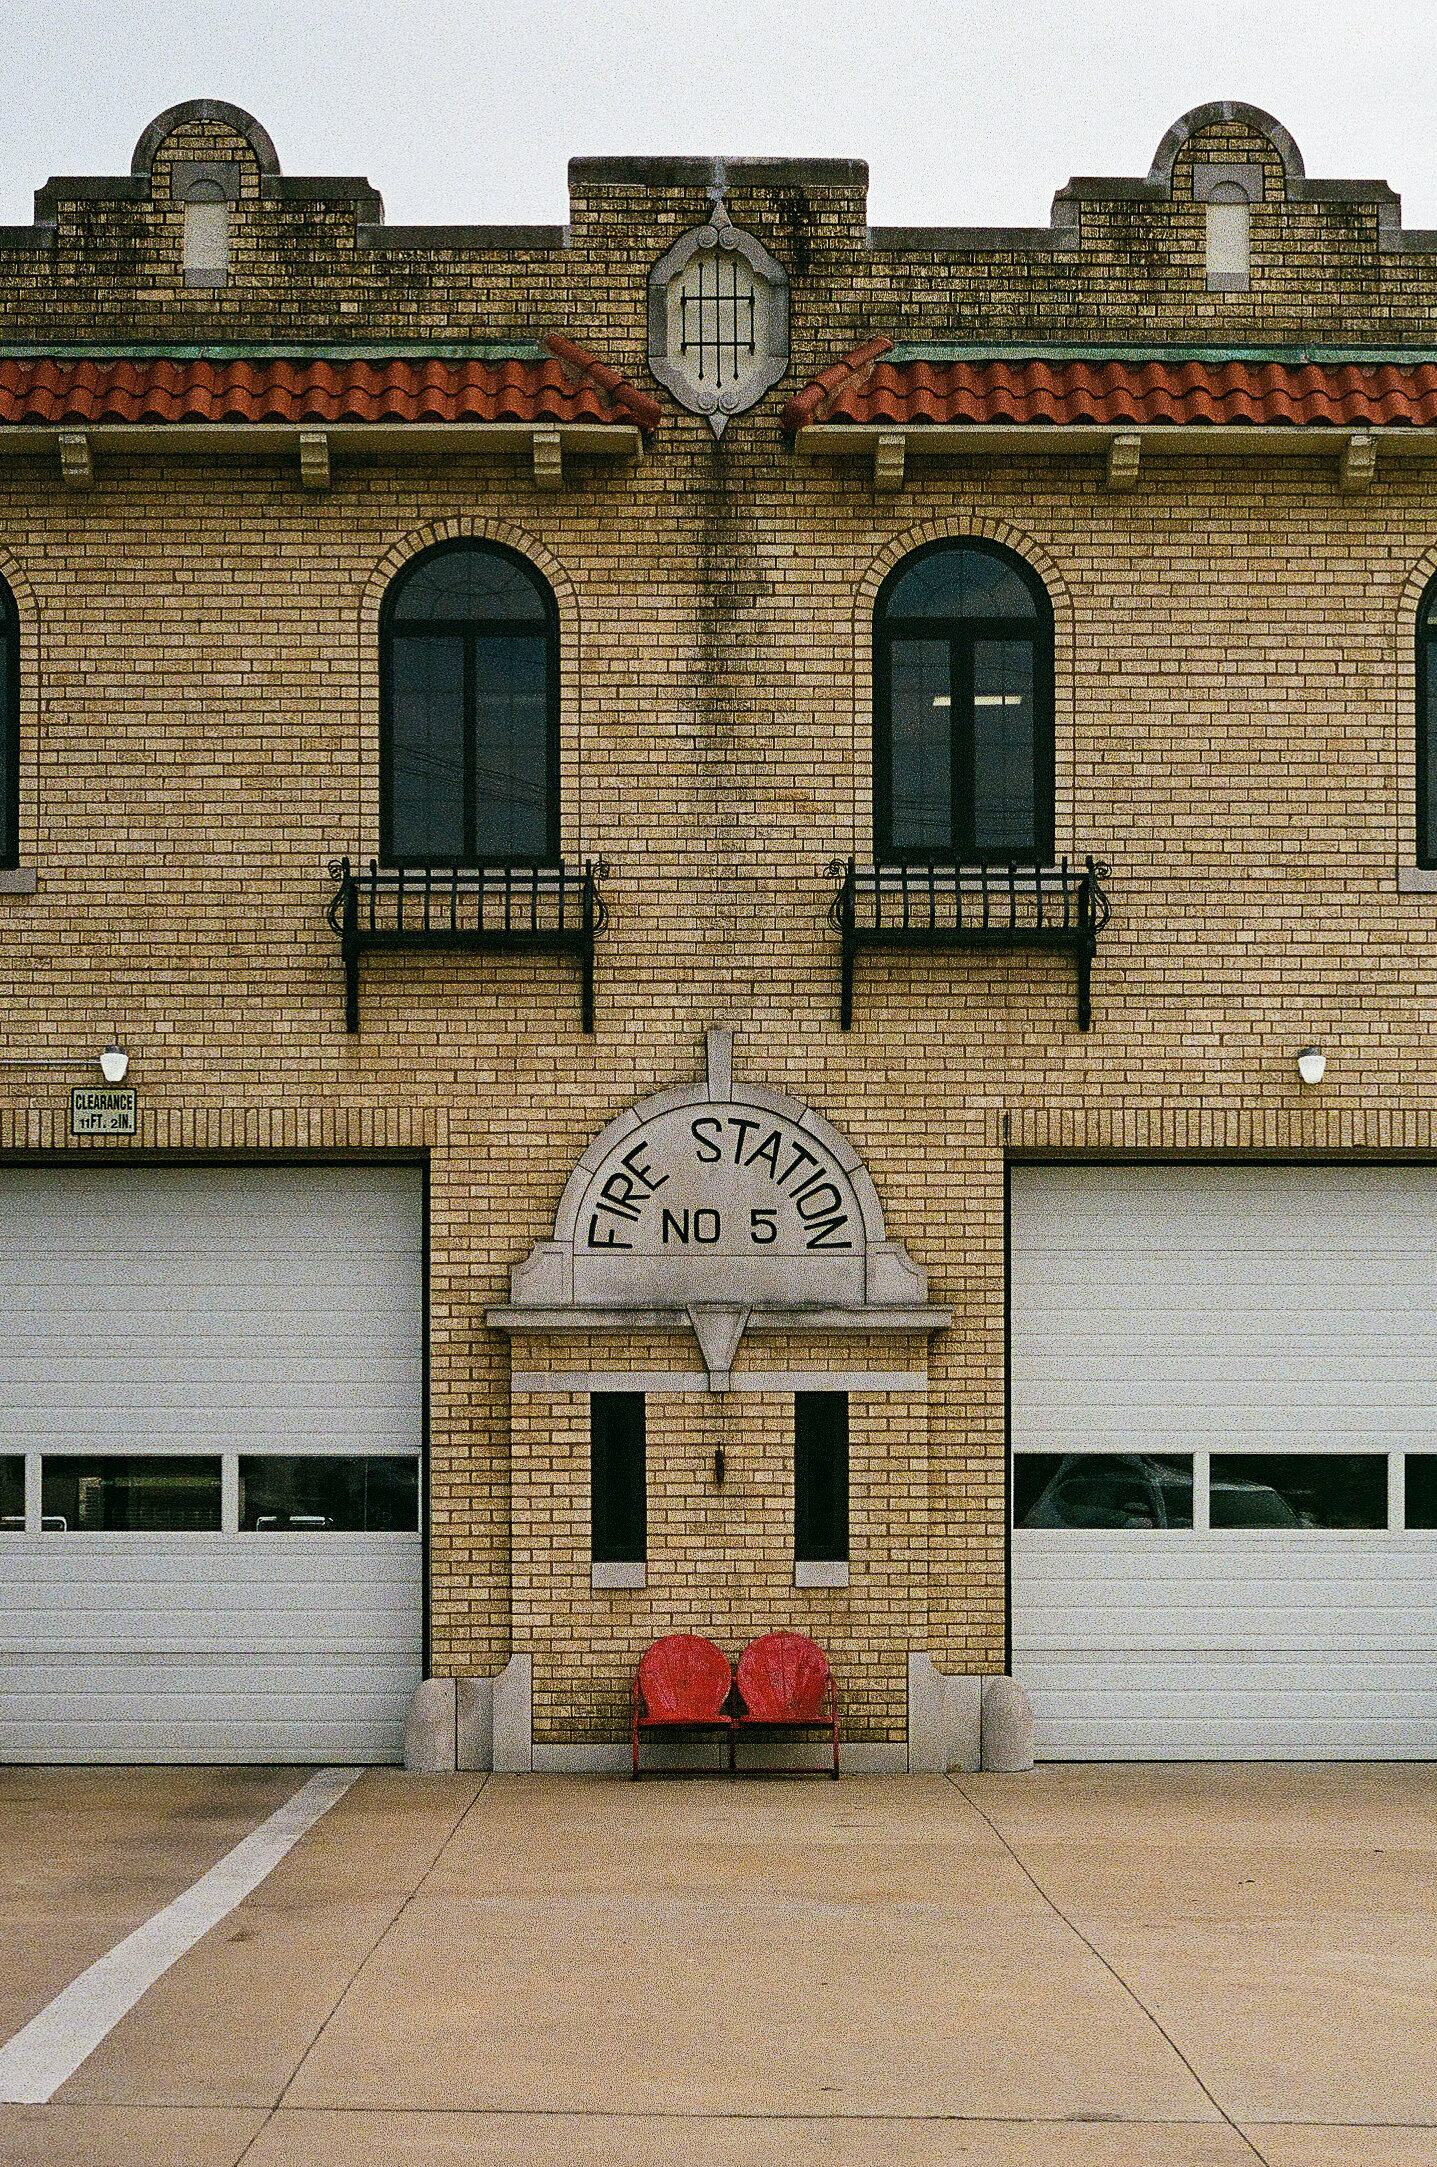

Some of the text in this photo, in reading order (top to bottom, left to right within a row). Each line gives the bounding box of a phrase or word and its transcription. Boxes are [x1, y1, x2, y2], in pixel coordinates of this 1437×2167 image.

[76, 1095, 133, 1110] CLEARANCE
[588, 1117, 852, 1249] FIRE STATION
[662, 1208, 777, 1244] NO 5
